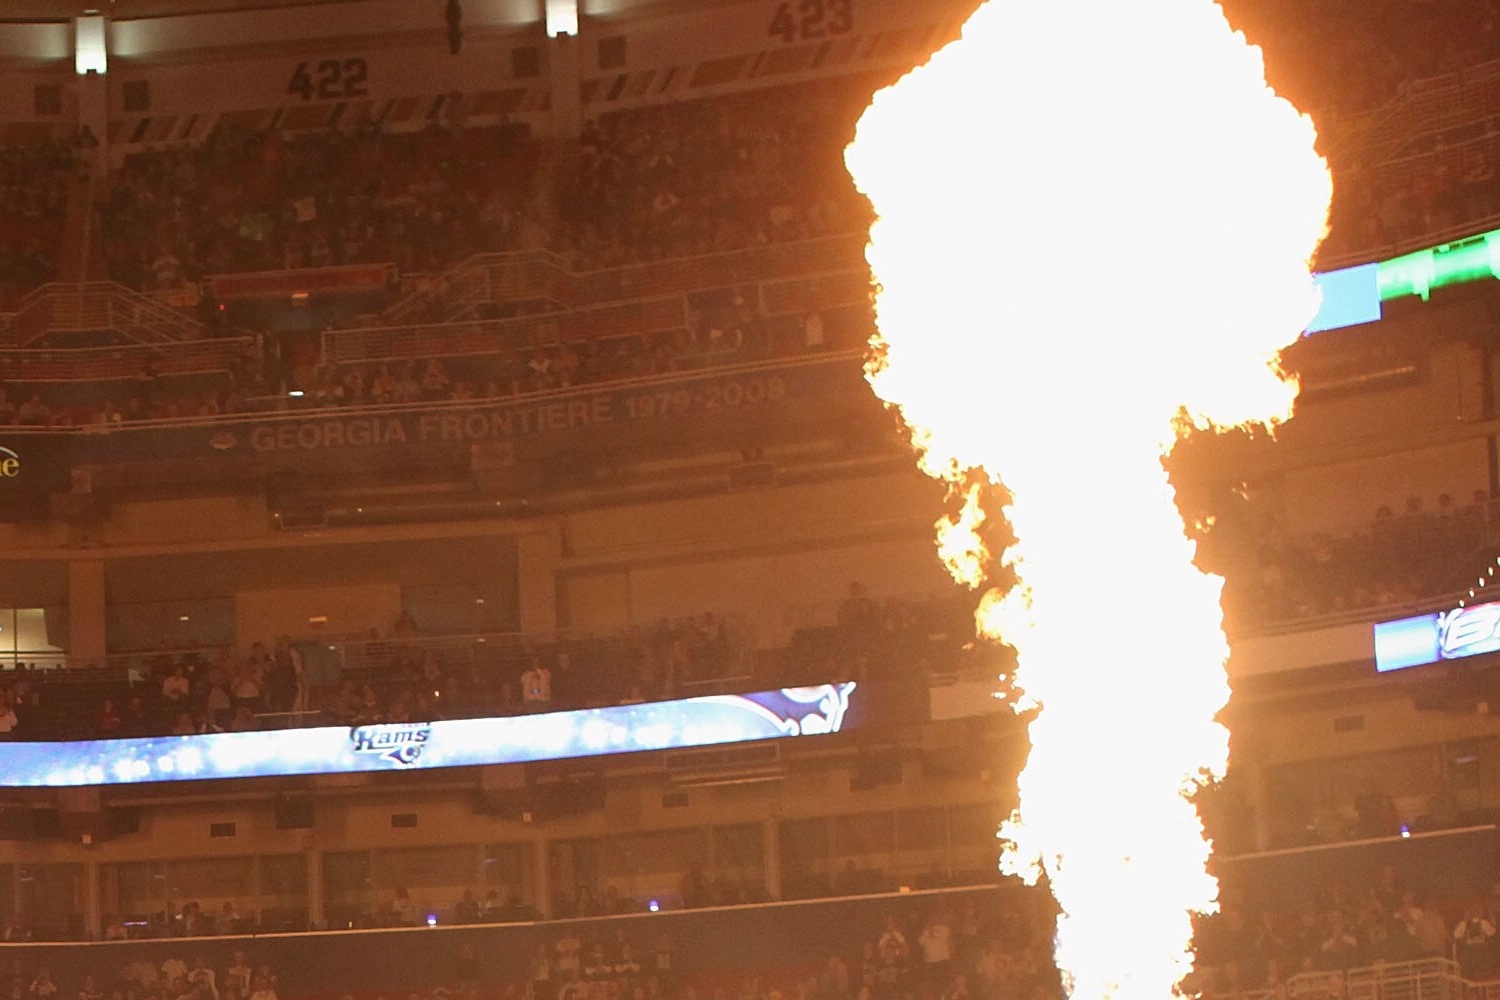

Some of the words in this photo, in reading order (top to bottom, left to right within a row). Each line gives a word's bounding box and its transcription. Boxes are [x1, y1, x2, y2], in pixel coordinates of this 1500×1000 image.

[768, 0, 853, 42] 423
[287, 57, 368, 100] 422
[252, 418, 407, 450] GEORGIA
[418, 395, 614, 443] FRONTIERE
